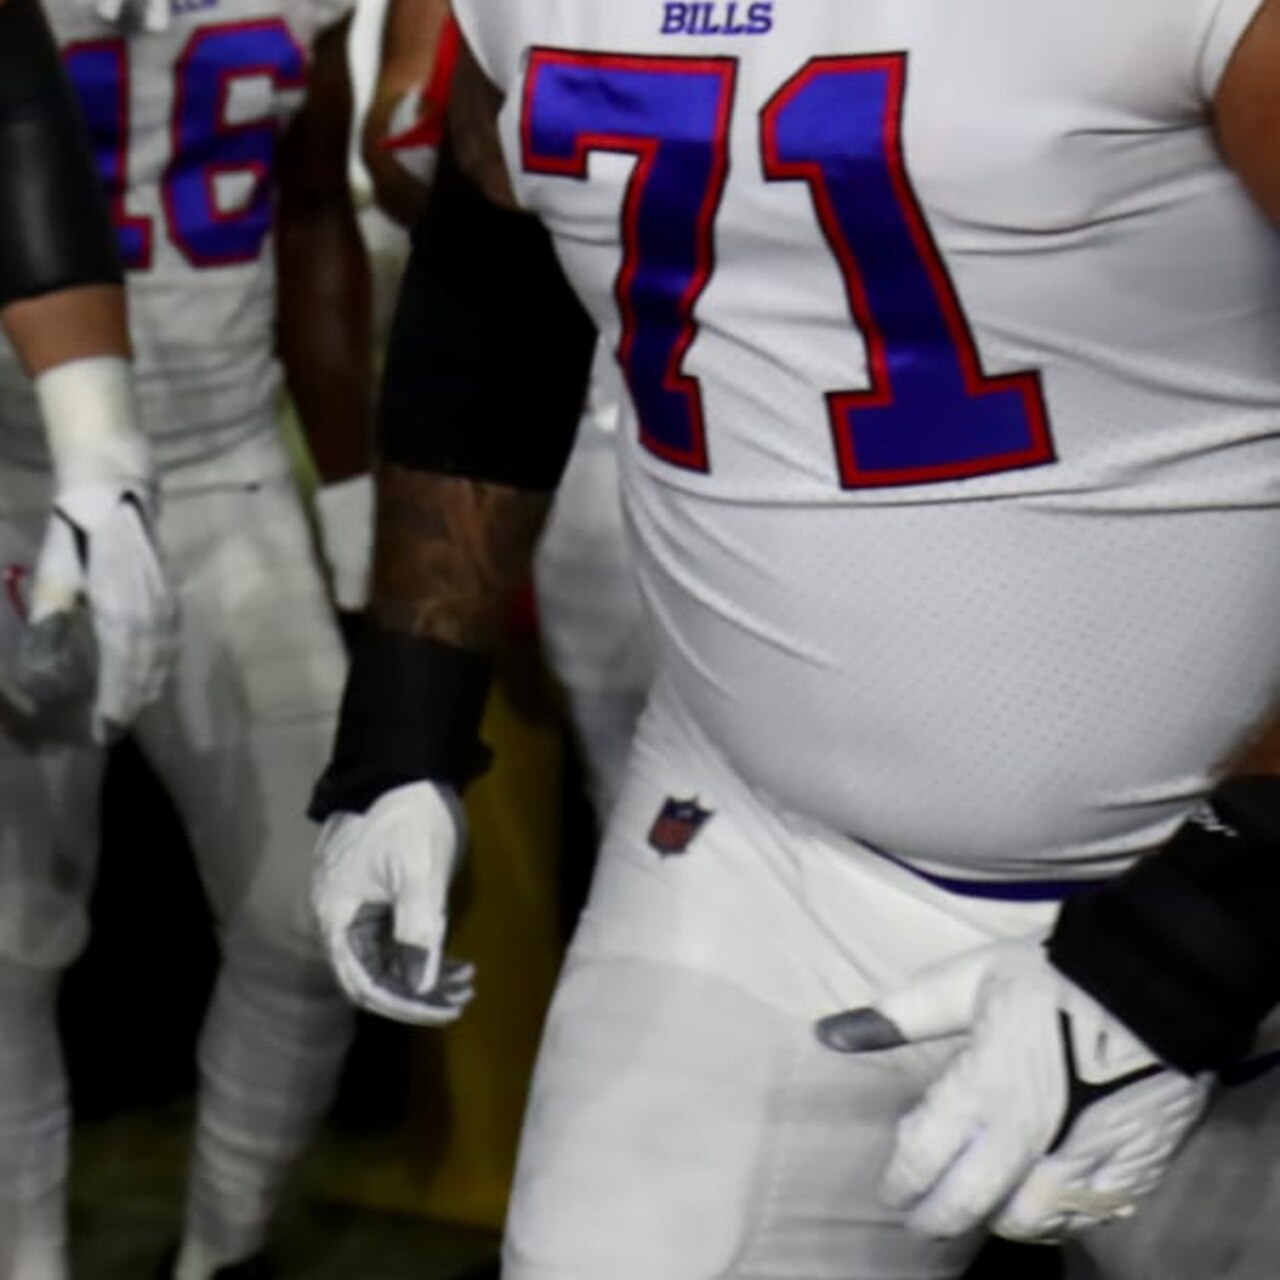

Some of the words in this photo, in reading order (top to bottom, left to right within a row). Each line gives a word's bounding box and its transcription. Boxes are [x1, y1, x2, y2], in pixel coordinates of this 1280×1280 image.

[61, 17, 308, 271] 16
[660, 1, 774, 36] BILLS
[520, 45, 1059, 490] 71
